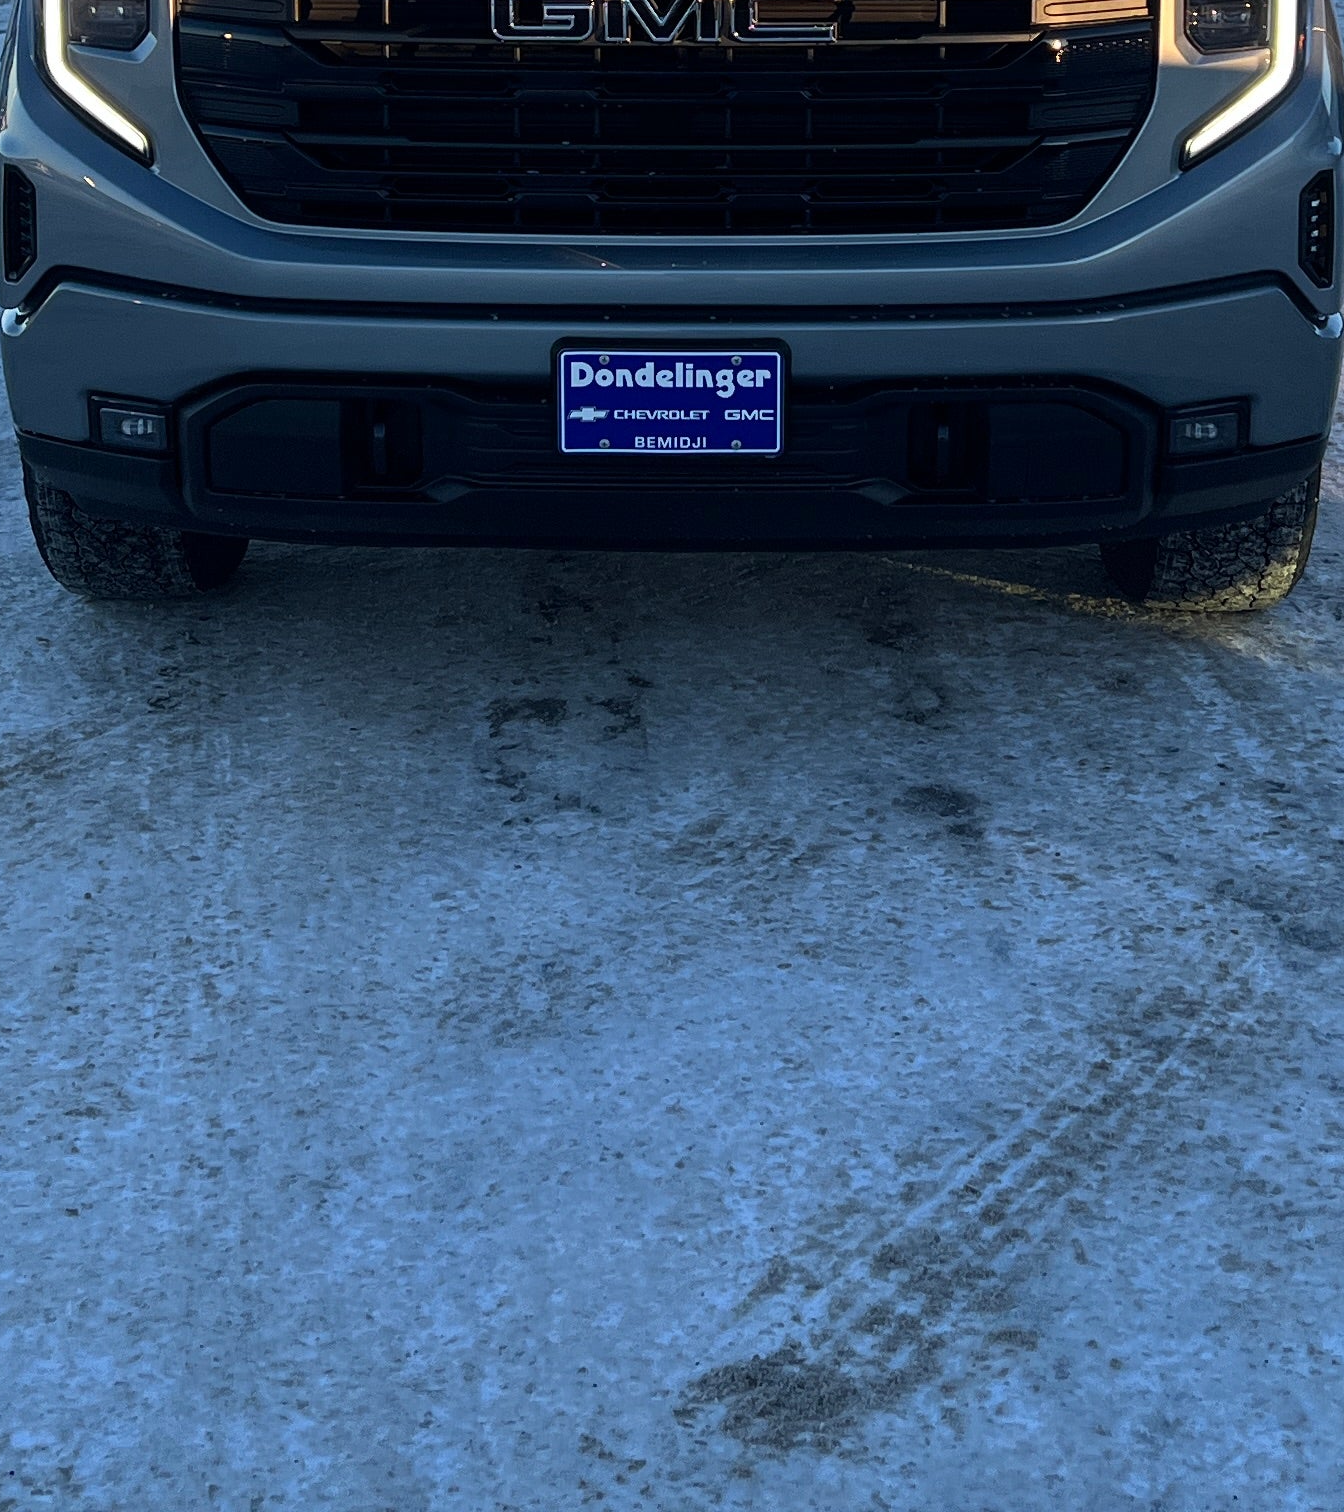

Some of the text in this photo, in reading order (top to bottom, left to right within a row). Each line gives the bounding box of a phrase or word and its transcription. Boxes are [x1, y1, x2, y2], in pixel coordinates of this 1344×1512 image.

[570, 361, 771, 398] Dondelinger
[613, 409, 775, 421] CHEVROLET GMC
[634, 436, 707, 449] BEMIDJI
